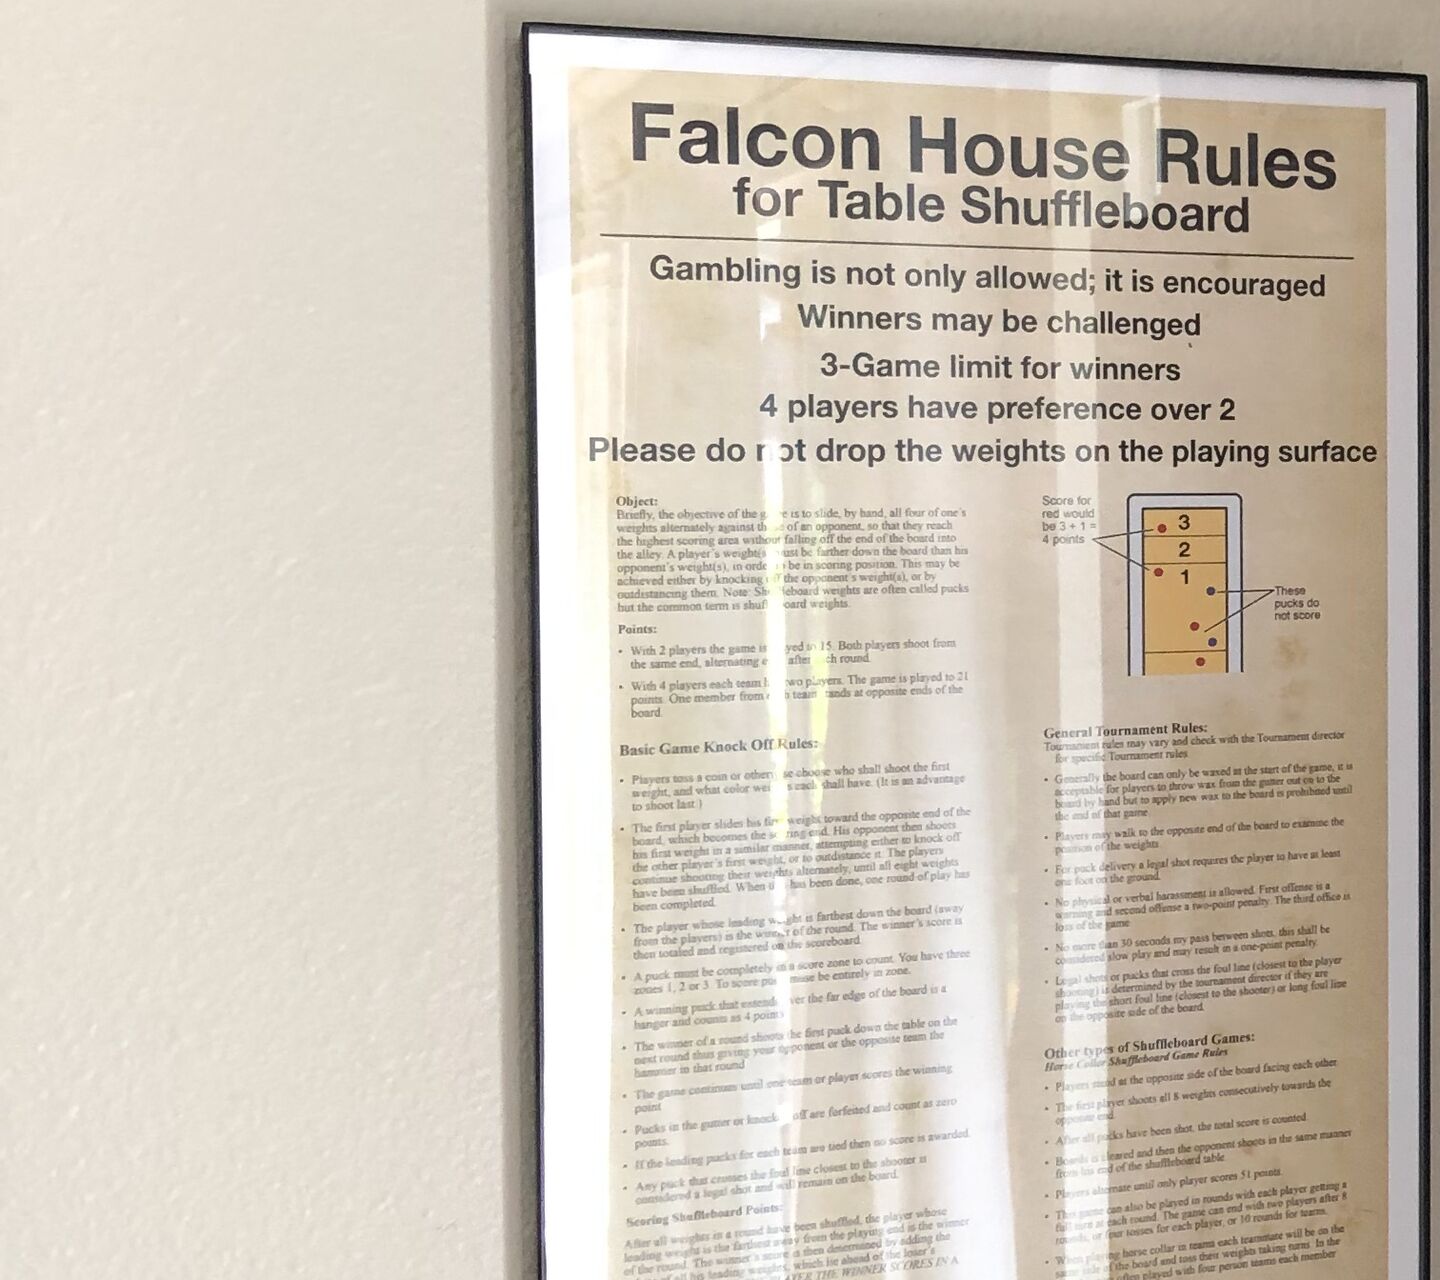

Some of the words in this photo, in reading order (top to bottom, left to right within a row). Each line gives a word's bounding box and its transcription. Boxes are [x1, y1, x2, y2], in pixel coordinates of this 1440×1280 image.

[631, 101, 881, 171] Falcon
[908, 115, 1131, 183] House
[1154, 128, 1338, 191] Rules
[731, 176, 804, 218] for
[817, 179, 946, 223] Table
[960, 184, 1250, 234] Shuffleboard
[648, 254, 801, 289] Gambling
[812, 259, 836, 284] is
[846, 263, 895, 287] not
[905, 263, 967, 293] only
[976, 265, 1096, 295] allowed;
[1105, 268, 1124, 292] it
[1132, 269, 1155, 294] is
[1163, 271, 1326, 302] encouraged
[797, 303, 922, 331] Winners
[931, 313, 993, 337] may
[1002, 308, 1038, 334] be
[1047, 310, 1201, 340] challenged
[820, 352, 940, 379] 3-Game
[949, 354, 1011, 380] limit
[1021, 355, 1062, 381] for
[1070, 357, 1181, 382] winners
[759, 394, 779, 418] 4
[787, 393, 898, 424] players
[908, 395, 978, 420] have
[987, 396, 1142, 424] preference
[1151, 401, 1213, 424] over
[1219, 398, 1236, 421] 2
[588, 437, 696, 463] Please
[705, 437, 747, 464] do
[816, 438, 886, 468] drop
[894, 438, 942, 463] the
[952, 438, 1066, 468] weights
[1075, 444, 1109, 463] on
[1118, 437, 1163, 463] the
[1172, 439, 1269, 471] playing
[1278, 440, 1378, 465] surface
[616, 496, 658, 508] Object:
[1042, 496, 1074, 507] Score
[1077, 496, 1091, 506] for
[658, 509, 674, 520] the
[677, 508, 725, 521] objective
[728, 508, 739, 519] of
[742, 508, 757, 518] the
[1042, 509, 1060, 519] red
[1063, 508, 1095, 518] would
[1178, 514, 1191, 531] 3
[1042, 522, 1056, 532] be
[1058, 522, 1066, 531] 3
[1042, 535, 1049, 544] 4
[1053, 534, 1085, 546] points
[1178, 542, 1191, 558] 2
[1180, 569, 1190, 585] 1
[1275, 586, 1306, 596] These
[1274, 598, 1304, 611] pucks
[1307, 598, 1320, 609] do
[1274, 610, 1290, 620] not
[1293, 611, 1321, 620] score
[617, 624, 658, 634] Points:
[631, 646, 657, 656] With
[659, 646, 666, 656] 2
[668, 644, 707, 658] players
[709, 644, 725, 654] the
[728, 646, 756, 657] game
[838, 640, 862, 651] Both
[864, 640, 900, 654] players
[903, 638, 930, 649] shoot
[932, 638, 957, 648] from
[1044, 726, 1093, 739] General
[1095, 724, 1168, 738] Tournament
[1171, 722, 1208, 734] Rules:
[1126, 740, 1146, 750] may
[1148, 739, 1168, 750] vary
[1172, 736, 1188, 746] and
[1190, 734, 1216, 746] check
[1219, 734, 1239, 744] with
[1241, 733, 1256, 743] the
[1257, 732, 1310, 743] Tournament
[1311, 730, 1346, 740] director
[618, 743, 655, 756] Basic
[659, 742, 700, 756] Game
[704, 739, 747, 753] Knock
[751, 738, 774, 752] Off
[776, 737, 819, 750] Rules:
[1044, 1046, 1081, 1060] Other
[1083, 1045, 1114, 1058] types
[1118, 1042, 1130, 1054] of
[1132, 1034, 1208, 1052] Shuffleboard
[1211, 1032, 1256, 1045] Games:
[1108, 1052, 1170, 1068] Shuffleboard
[1172, 1049, 1200, 1061] Game
[1202, 1046, 1228, 1058] Rules
[1126, 1127, 1148, 1138] have
[1150, 1126, 1172, 1137] been
[1198, 1120, 1212, 1132] the
[1214, 1118, 1234, 1130] total
[1236, 1118, 1260, 1128] score
[1134, 1180, 1154, 1192] until
[1157, 1178, 1176, 1190] only
[1180, 1175, 1208, 1189] player
[1210, 1172, 1238, 1184] scores
[626, 1216, 670, 1228] Scoring
[672, 1207, 743, 1224] Shuffleboard
[746, 1204, 783, 1216] Points:
